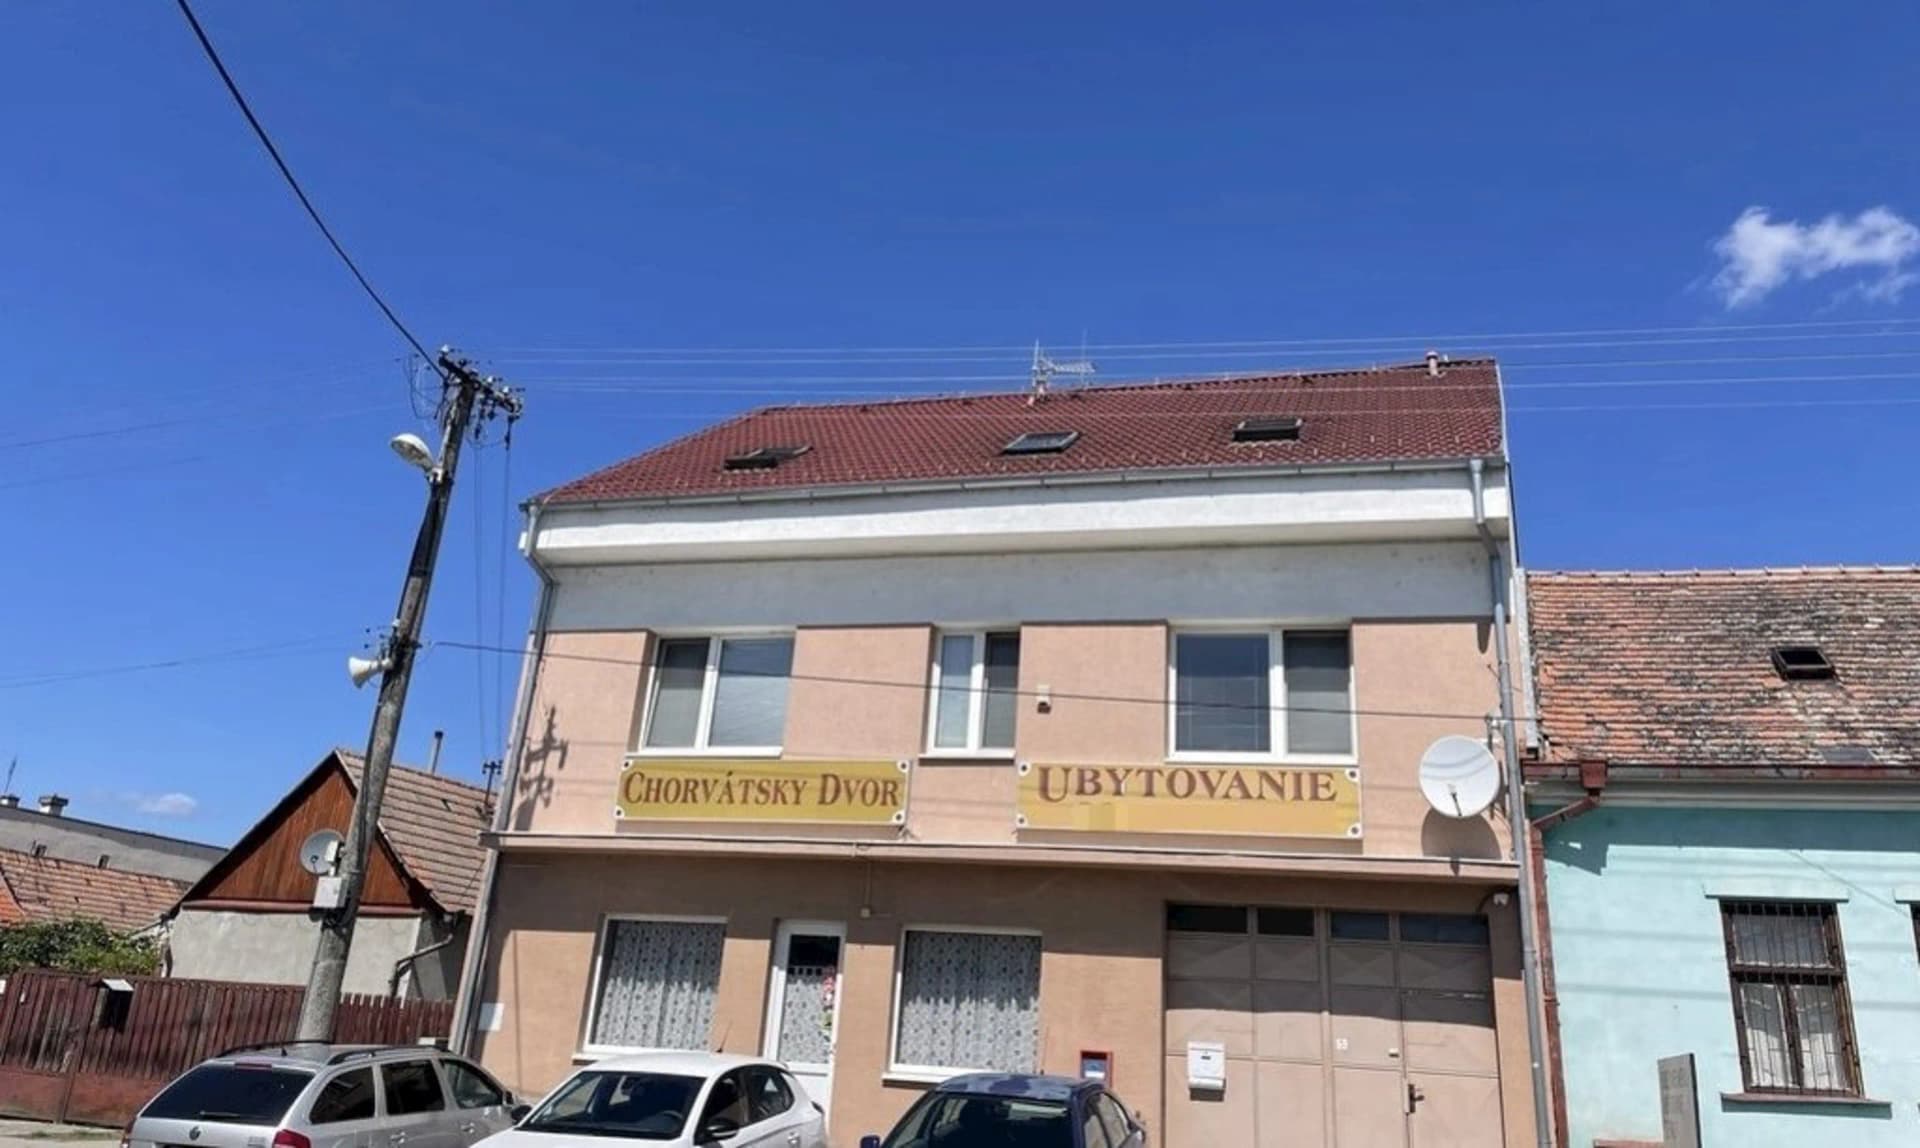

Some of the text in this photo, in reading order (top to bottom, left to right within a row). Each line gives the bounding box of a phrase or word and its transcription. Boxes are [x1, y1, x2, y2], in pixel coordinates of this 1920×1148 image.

[623, 771, 900, 807] CHORVÁTSKY DVOR
[1038, 766, 1337, 802] UBYTOVANIE
